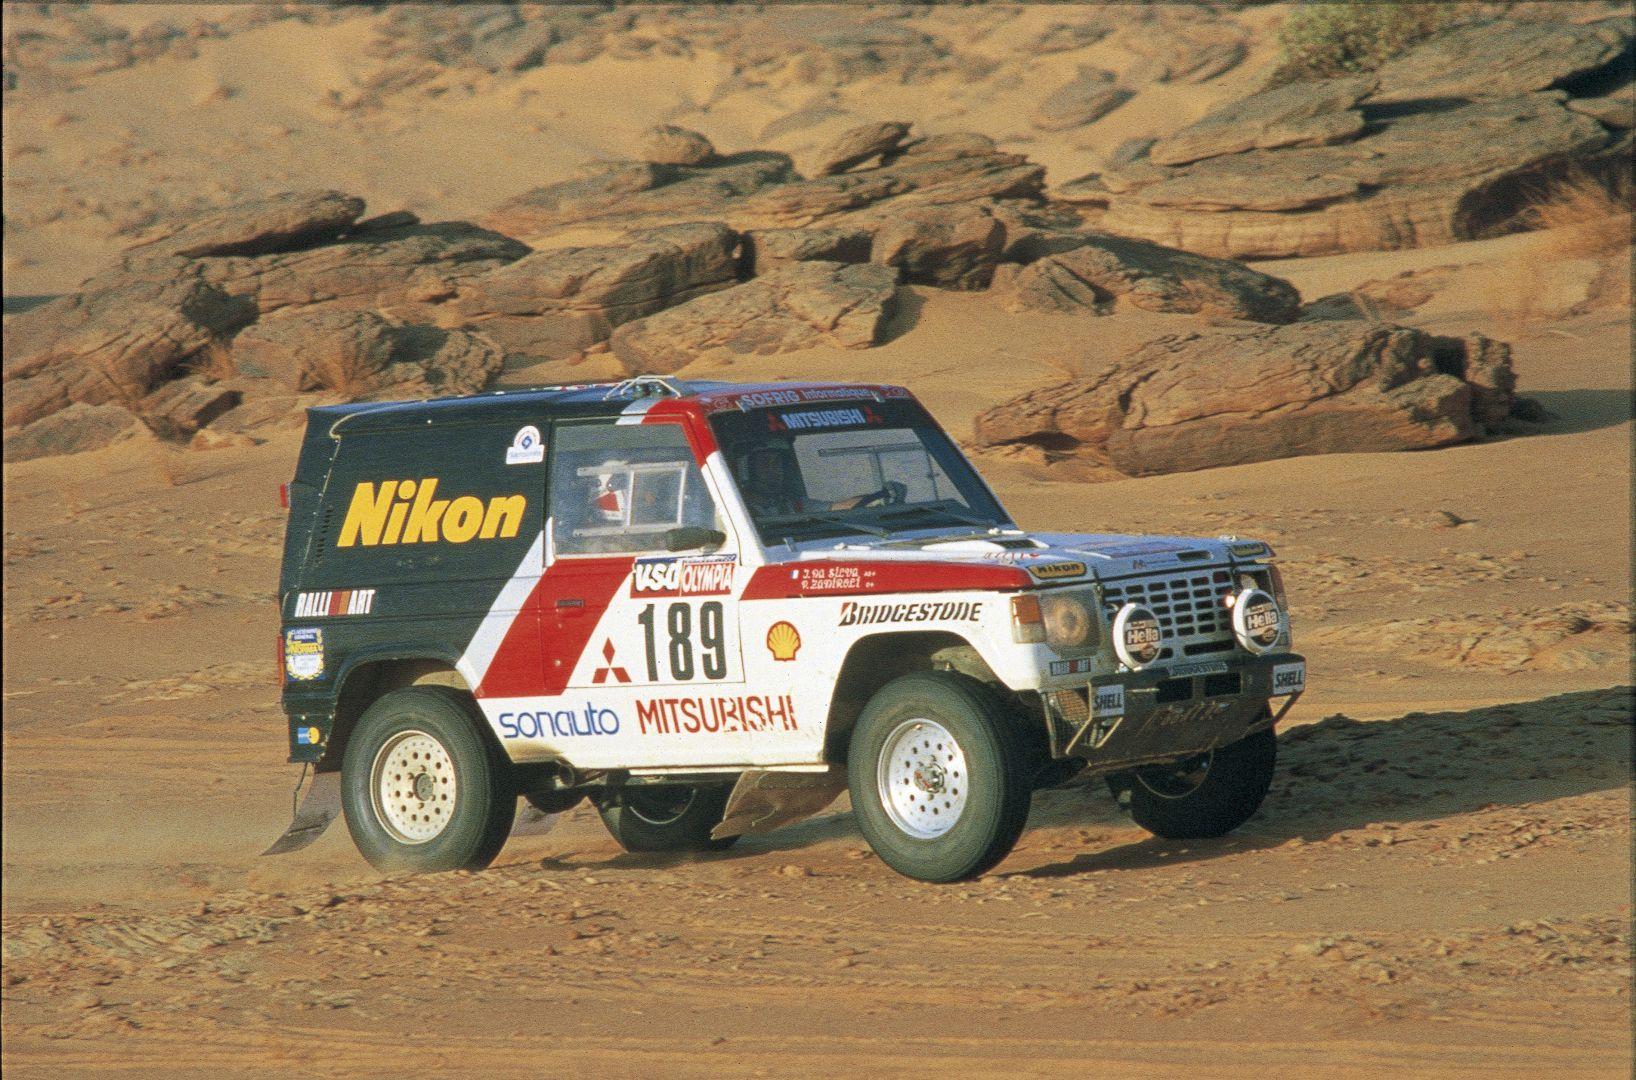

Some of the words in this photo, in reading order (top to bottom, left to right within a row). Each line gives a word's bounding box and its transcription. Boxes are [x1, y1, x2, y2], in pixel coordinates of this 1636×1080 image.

[781, 409, 866, 430] MITSUBISHI
[337, 478, 527, 548] Nikon
[682, 563, 734, 593] OLYMPIA
[838, 602, 983, 626] BRIDGESTONE
[1246, 610, 1278, 631] Hella
[638, 601, 727, 681] 189
[1126, 627, 1159, 645] Hella
[1275, 669, 1304, 689] SHELL
[1094, 693, 1122, 710] SHELL
[499, 701, 620, 739] sonauto
[635, 695, 799, 735] MITSUBISHI
